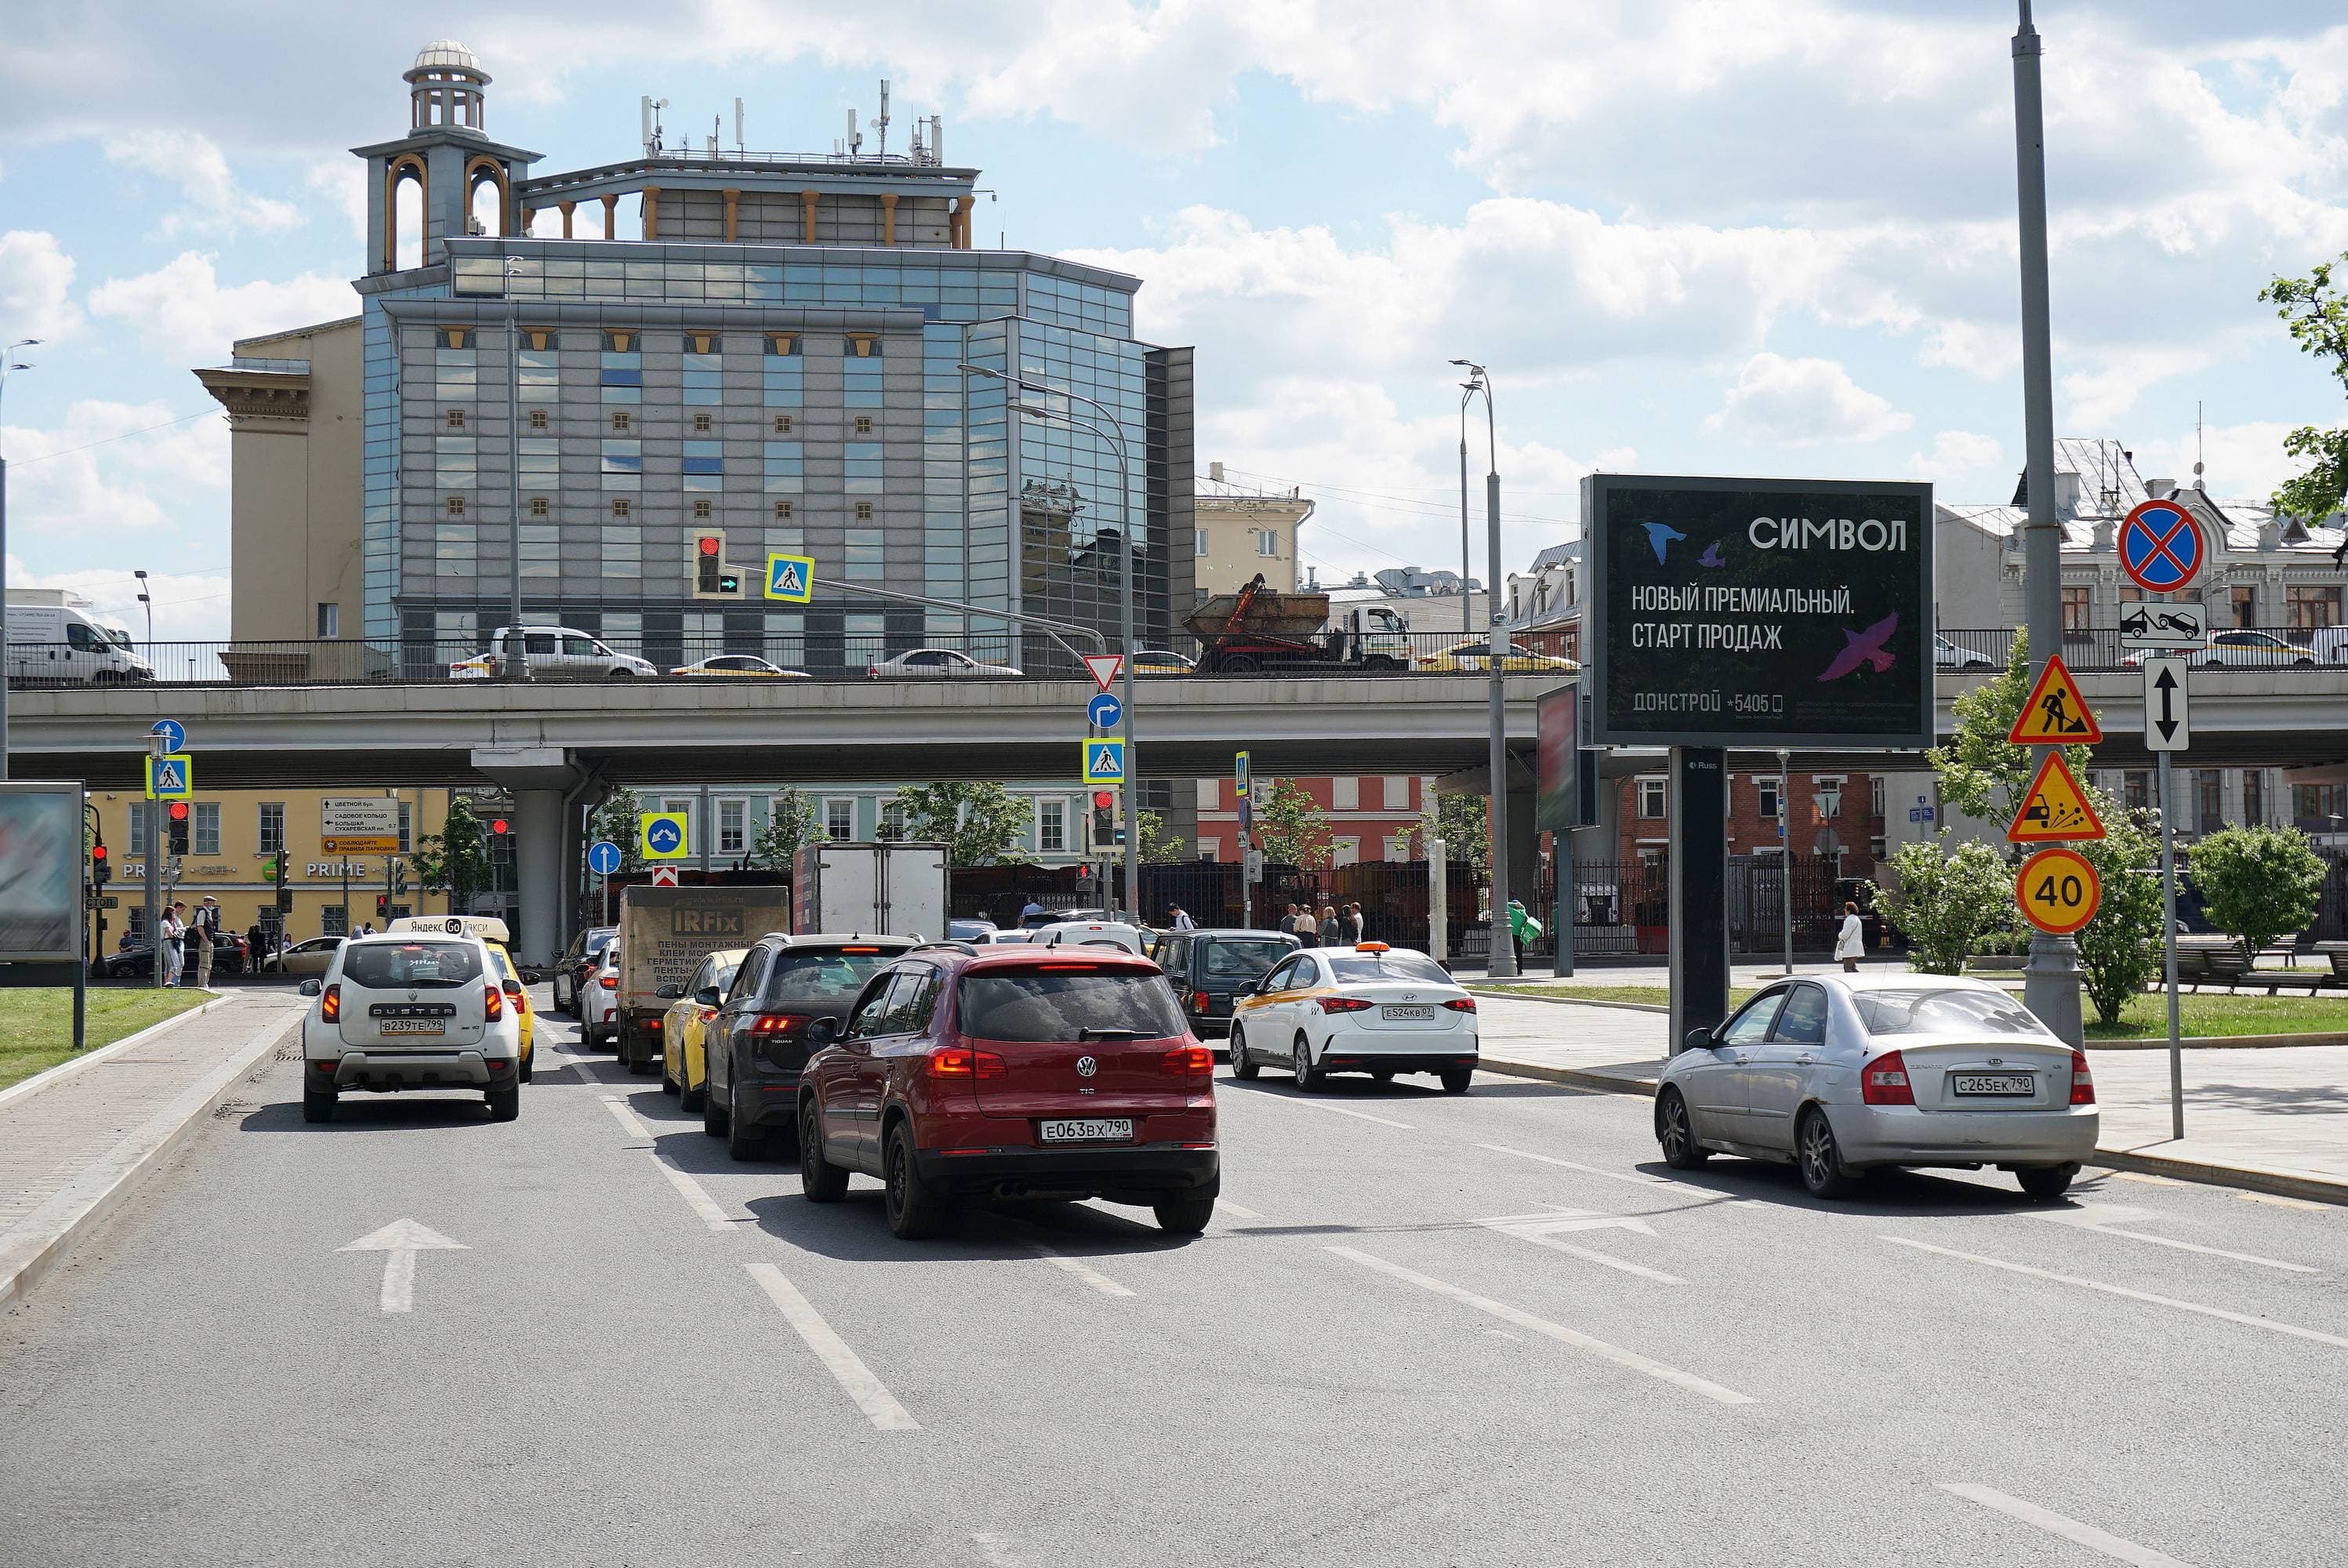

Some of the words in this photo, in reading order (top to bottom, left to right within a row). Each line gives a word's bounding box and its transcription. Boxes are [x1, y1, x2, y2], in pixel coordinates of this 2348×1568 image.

[1748, 517, 1907, 552] СИМВОЛ
[1631, 582, 1699, 612] НОВЫЙ
[1704, 585, 1856, 615] ПРЕМИАЛЬНЫЙ.
[1631, 622, 1693, 649] СТАРТ
[1698, 624, 1783, 652] ПРОДАЖ
[1632, 689, 1722, 712] ДОНСТРОЙ
[123, 864, 182, 878] PRM
[307, 862, 365, 877] PRIME
[2034, 875, 2083, 907] 40
[86, 898, 114, 907] СТОП
[411, 920, 443, 933] Яндекс
[447, 921, 460, 933] Go
[674, 910, 739, 932] IRFix
[1960, 1078, 2009, 1091] С265ЕК
[2010, 1077, 2030, 1088] 790
[1047, 1122, 1106, 1138] Е063ВХ
[1106, 1120, 1129, 1132] 790
